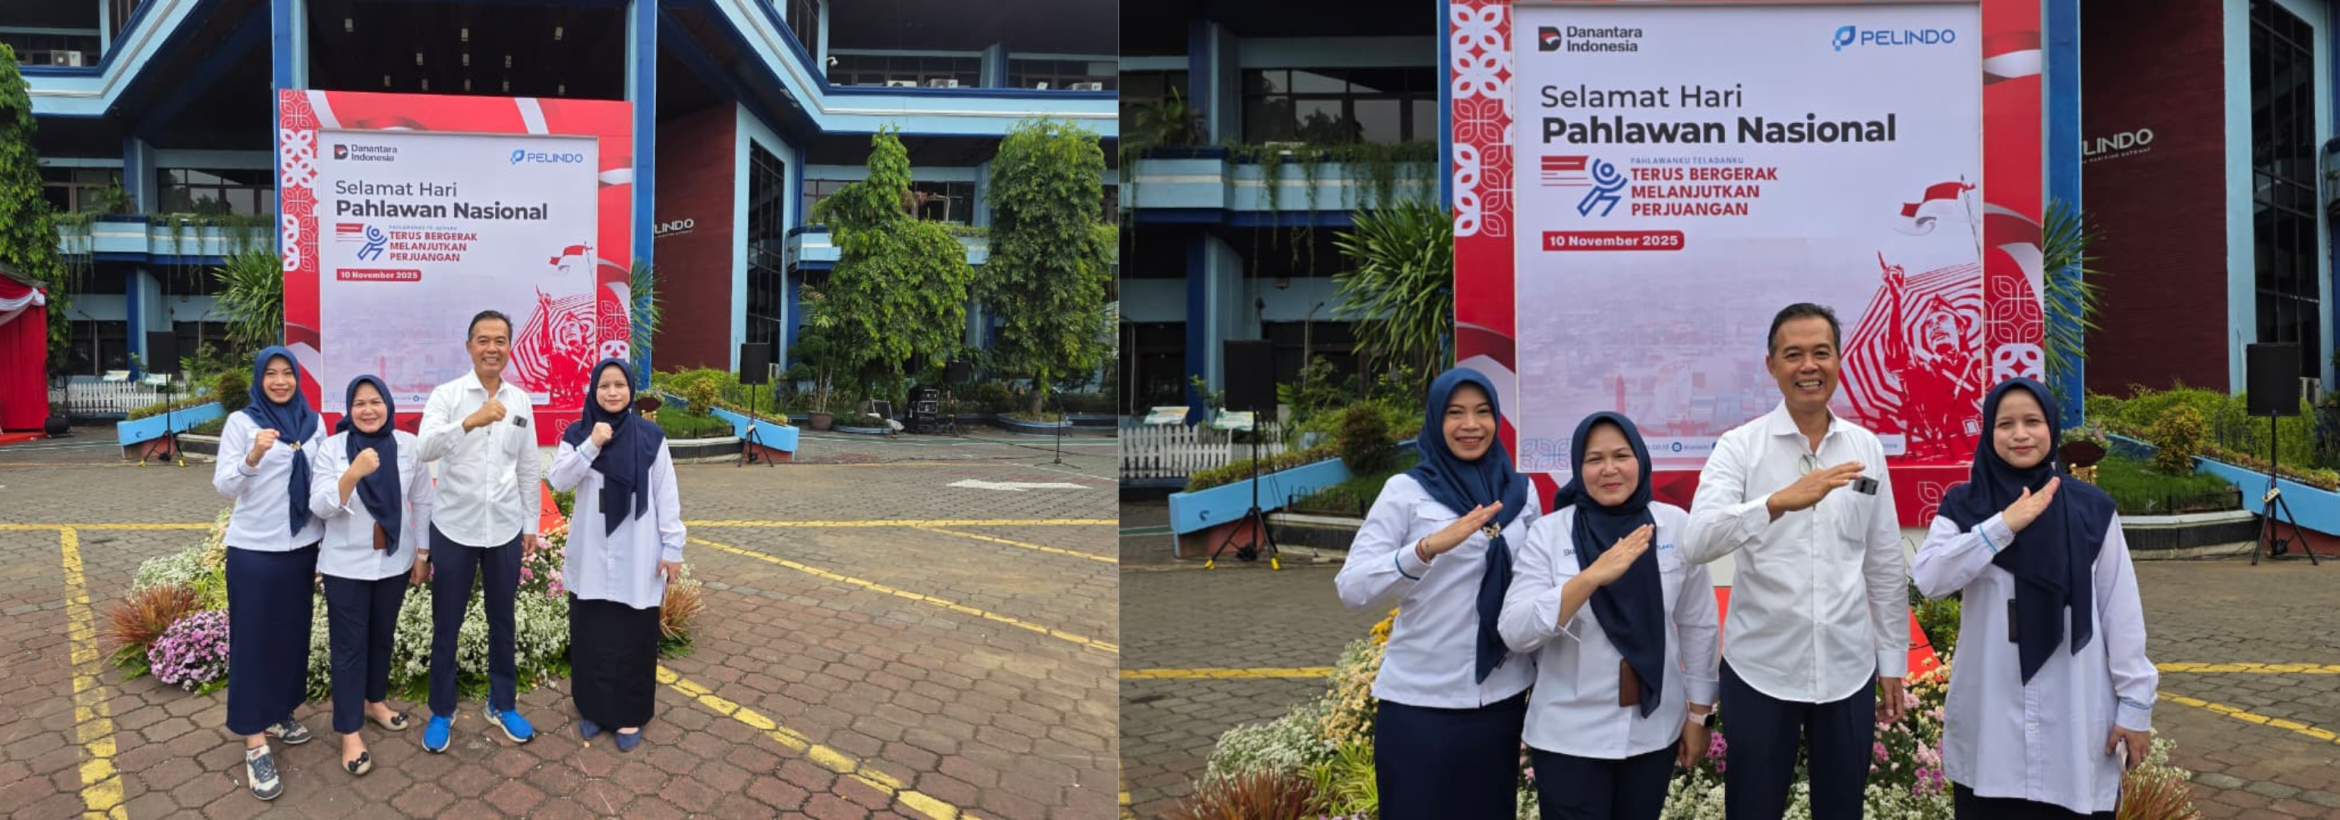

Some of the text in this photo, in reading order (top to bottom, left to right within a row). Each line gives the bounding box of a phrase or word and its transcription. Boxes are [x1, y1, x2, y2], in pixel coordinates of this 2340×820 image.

[1567, 26, 1643, 39] Danantara
[1861, 29, 1956, 46] PELINDO
[1567, 40, 1638, 53] Indonesia
[1541, 84, 1743, 108] Selamat Hari
[1542, 113, 1897, 144] Pahlawan Nasional
[351, 143, 398, 154] Danantara
[351, 153, 395, 162] Indonesia
[527, 152, 583, 163] PELINDO
[1631, 167, 1778, 181] TERUS BERGERAK
[335, 180, 457, 197] Selamat Hari
[1631, 185, 1760, 199] MELANJUTKAN
[336, 199, 548, 220] Pahlawan Nasional
[1631, 203, 1748, 216] PERJUANGAN
[390, 232, 478, 241] TERUS BERGERAK
[1549, 234, 1678, 247] 10 November 2025
[390, 242, 467, 251] MELANJUTKAN
[390, 252, 460, 262] PERJUANGAN
[340, 271, 351, 279] 10
[352, 271, 394, 279] November
